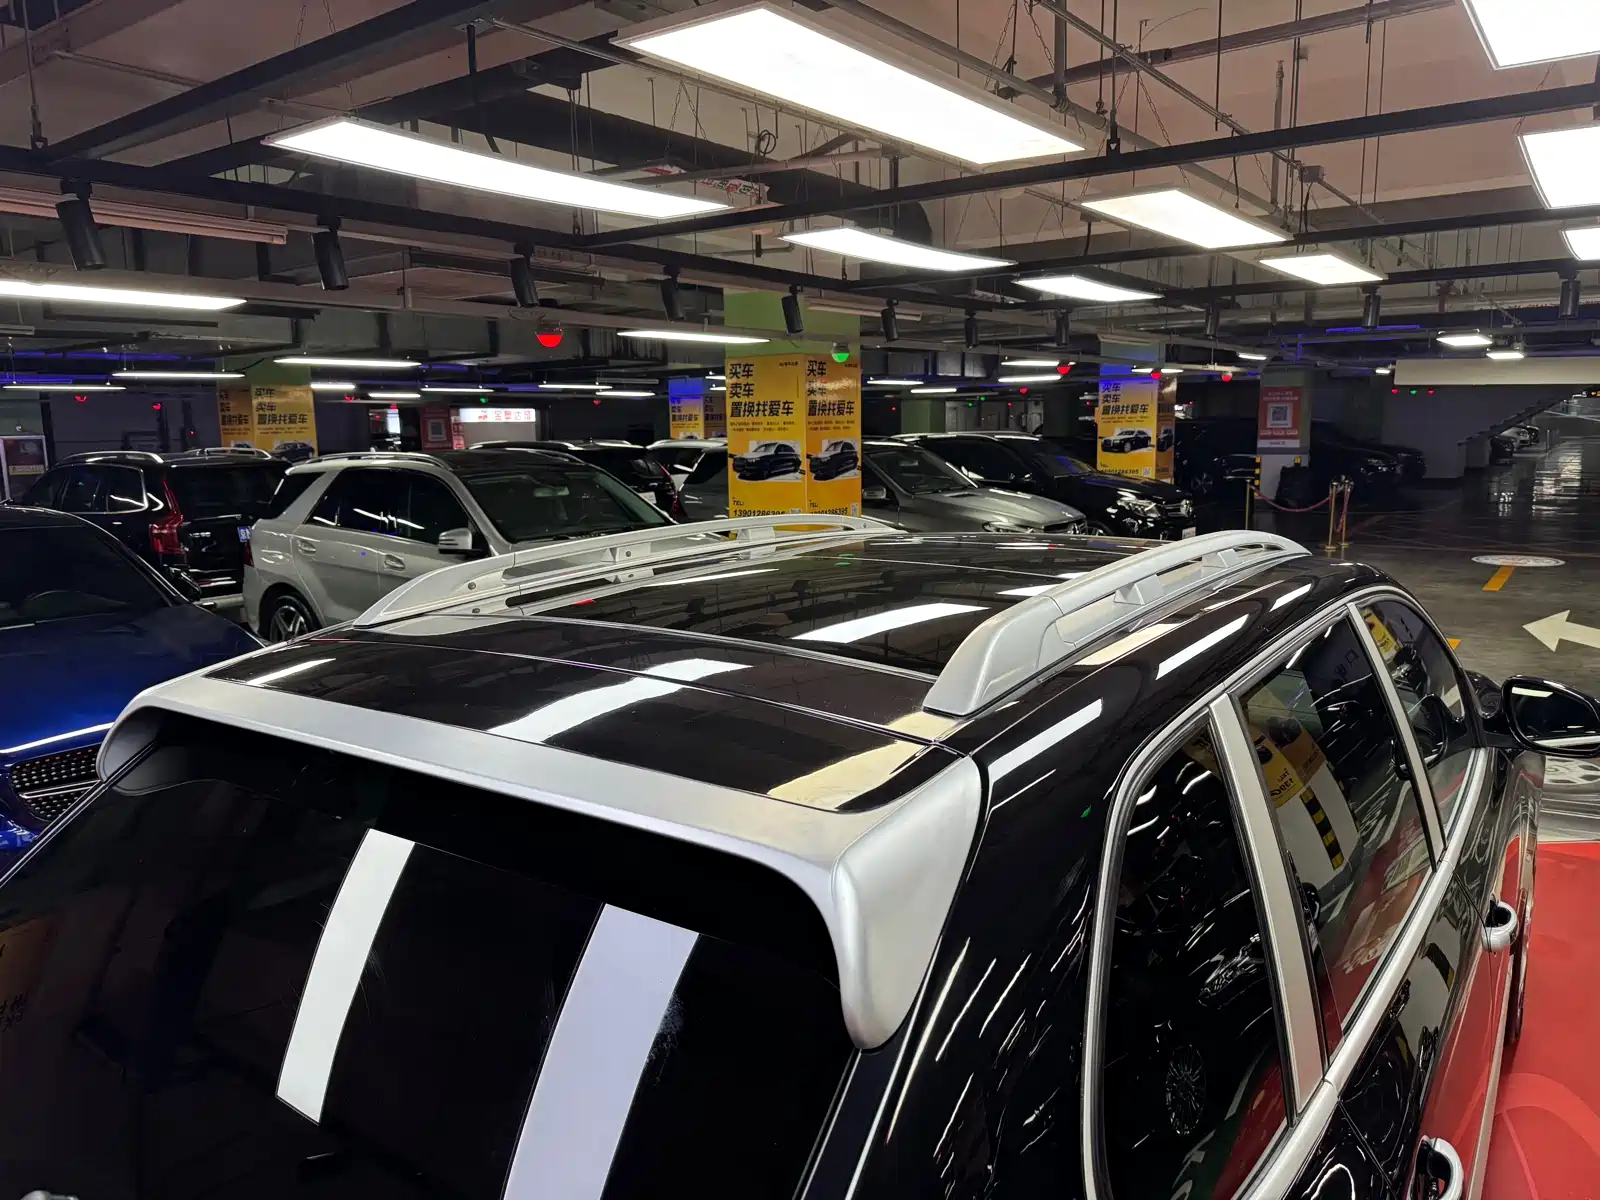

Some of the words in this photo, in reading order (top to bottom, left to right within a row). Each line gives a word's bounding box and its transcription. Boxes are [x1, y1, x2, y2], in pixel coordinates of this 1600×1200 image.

[729, 363, 755, 379] 买车
[807, 360, 827, 376] 买车
[729, 382, 755, 398] 卖车
[730, 401, 795, 417] 置换找爱车
[808, 400, 856, 416] 置换找爱车
